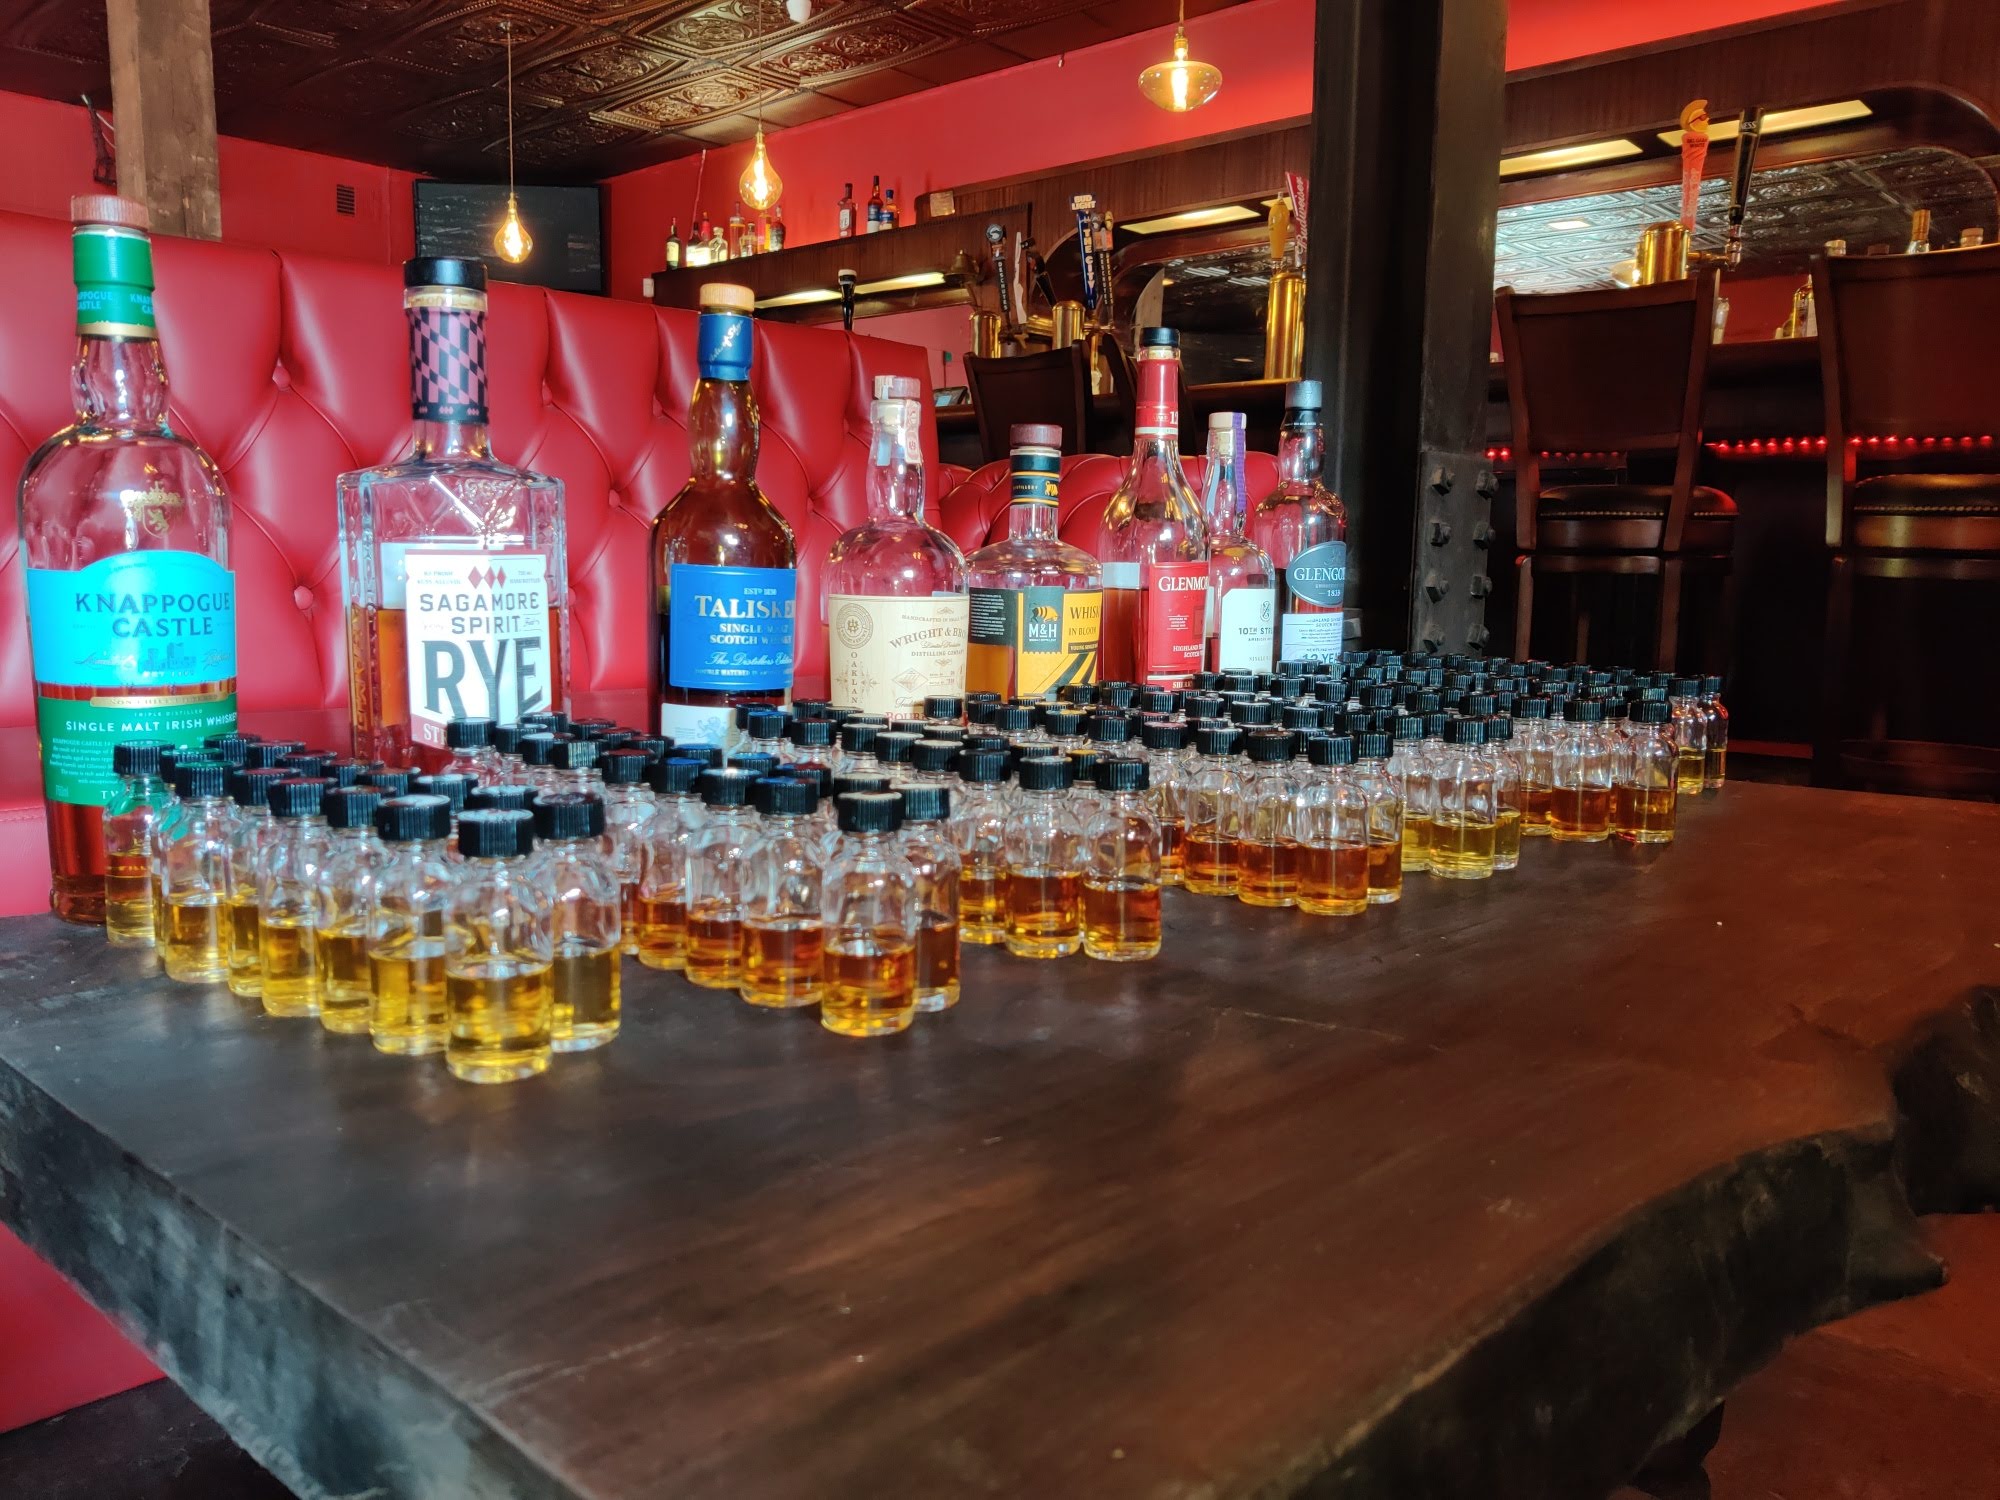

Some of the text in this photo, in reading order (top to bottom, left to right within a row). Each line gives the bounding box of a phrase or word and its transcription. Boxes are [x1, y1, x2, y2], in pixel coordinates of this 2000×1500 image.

[1071, 201, 1097, 210] LIGHT
[1073, 194, 1093, 202] BUD
[1295, 175, 1307, 254] Budweiser
[997, 261, 1009, 311] DESCHUTES
[75, 593, 230, 614] KNAPPOGUE
[420, 592, 539, 612] SAGAMORE
[112, 616, 214, 638] CASTLE
[451, 615, 520, 635] SPIRIT
[719, 623, 763, 633] SINGLE
[1028, 623, 1058, 638] M&H
[1238, 627, 1258, 635] 10TH
[709, 634, 759, 645] SCOTCH
[889, 627, 944, 649] WRIGHT
[944, 628, 953, 637] &
[704, 651, 729, 666] The
[421, 636, 543, 723] RYE
[65, 720, 115, 732] SINGLE
[121, 721, 160, 732] MALT
[166, 718, 202, 731] IRISH
